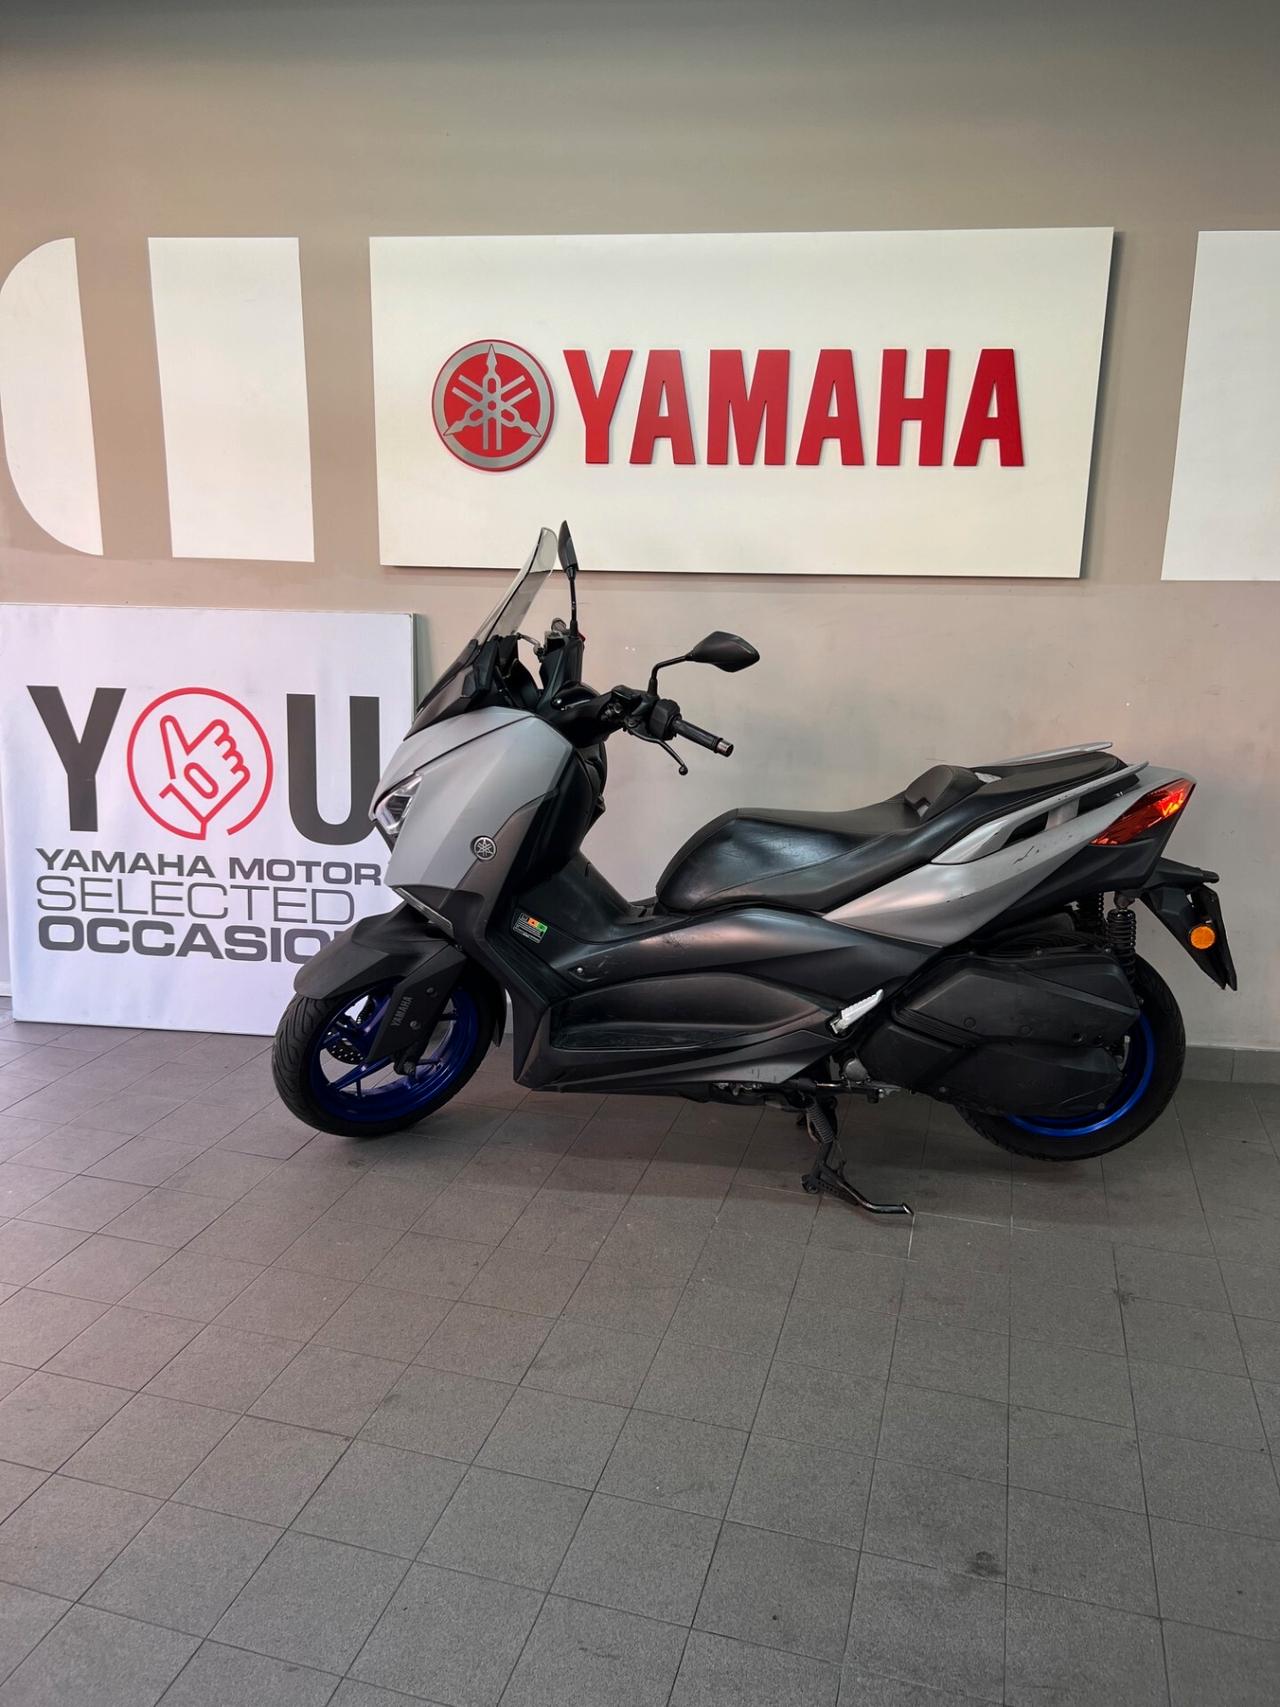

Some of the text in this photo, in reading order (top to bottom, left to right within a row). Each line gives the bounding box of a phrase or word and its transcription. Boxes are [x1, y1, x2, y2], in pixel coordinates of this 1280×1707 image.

[563, 348, 1024, 467] YAMAHA
[35, 848, 381, 886] YAMAHA MOTOR
[36, 875, 355, 926] SELECTED
[38, 915, 345, 965] OCCASIO
[390, 996, 413, 1027] YAMAHA
